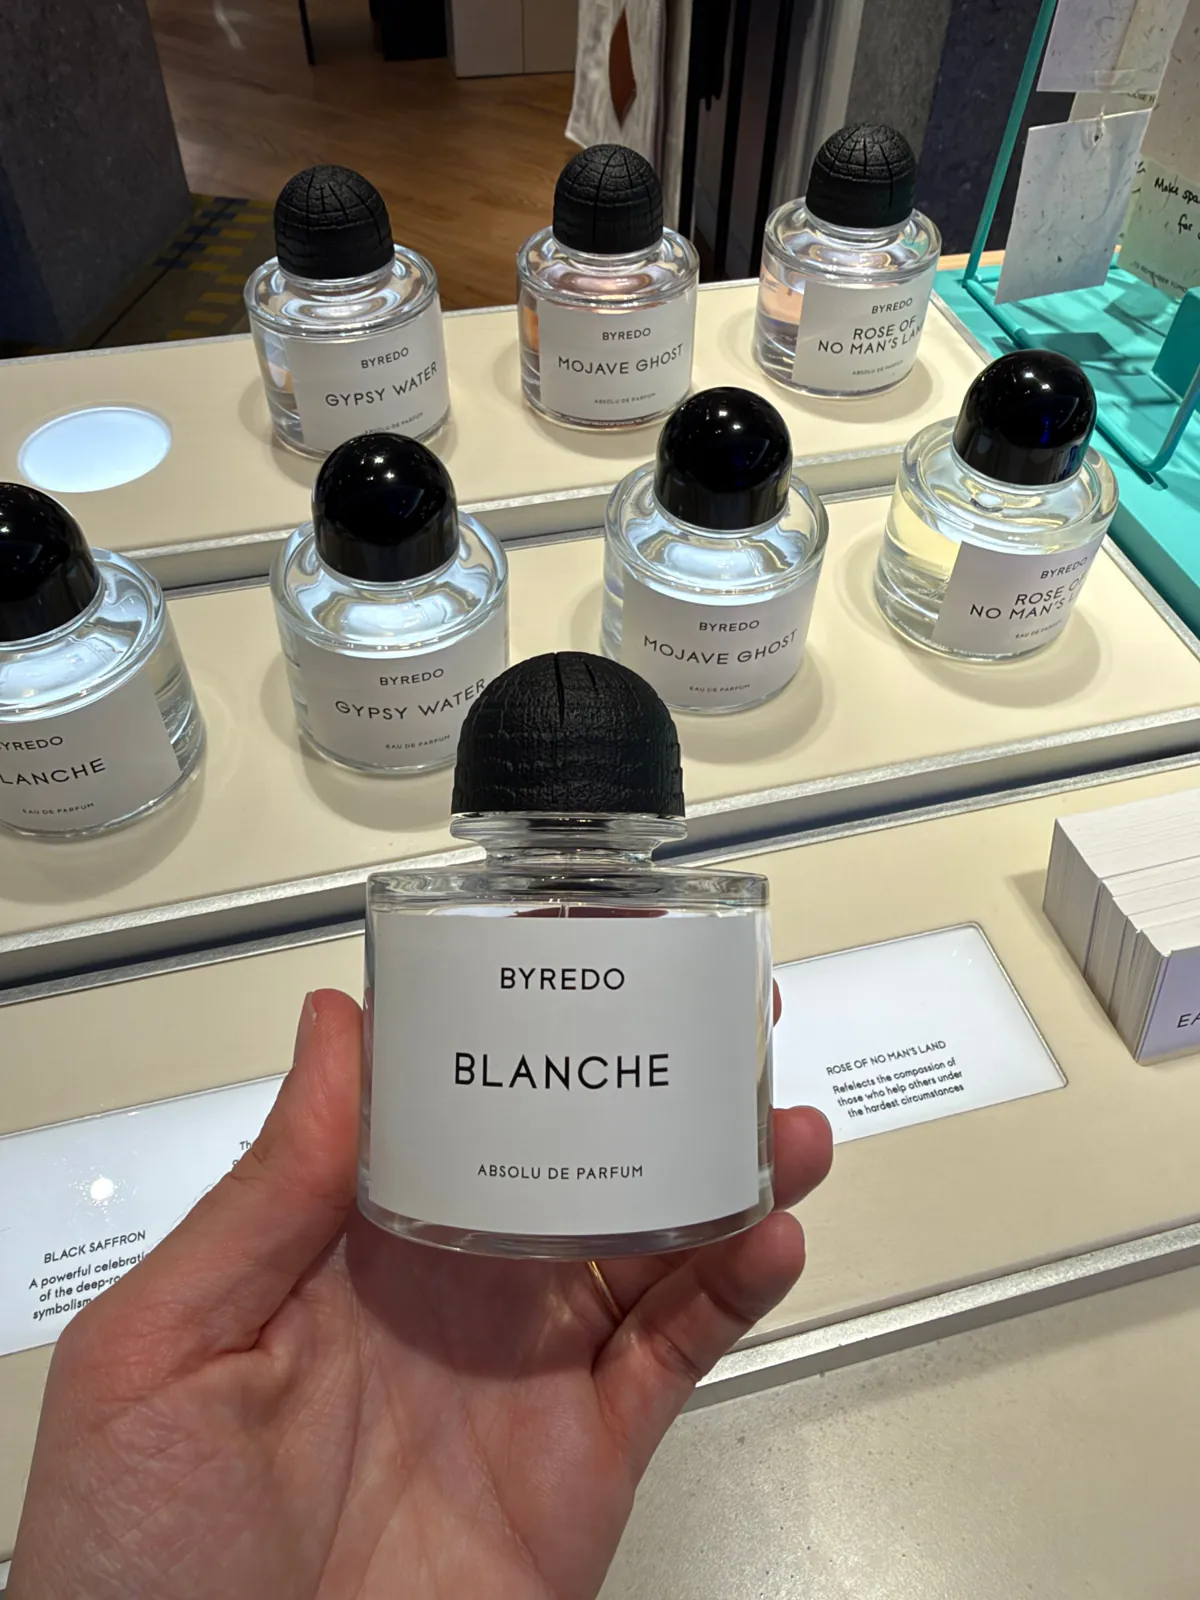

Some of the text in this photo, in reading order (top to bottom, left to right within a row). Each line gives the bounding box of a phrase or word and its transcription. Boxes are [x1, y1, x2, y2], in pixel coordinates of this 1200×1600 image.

[1154, 176, 1200, 205] Make spa
[1178, 213, 1193, 234] for
[871, 297, 913, 314] BYREDO
[602, 327, 651, 341] BYREDO
[818, 321, 923, 355] NO MAN'S LAN
[853, 315, 917, 341] ROSE OF
[360, 347, 409, 369] BYREDO
[558, 342, 683, 375] MOJAVE GHOST
[325, 361, 438, 407] GYPSY WATER
[1040, 556, 1088, 579] BYREDO
[1014, 585, 1065, 606] ROSE
[969, 603, 1002, 620] NO
[1008, 597, 1067, 620] MAN'S
[699, 620, 760, 633] BYREDO
[643, 628, 798, 665] MOJAVE GHOST
[379, 668, 444, 686] BYREDO
[719, 684, 750, 692] PARFUM
[335, 678, 486, 720] GYPSY WATER
[0, 736, 64, 751] YREDO
[418, 734, 451, 747] PARFUM
[0, 758, 106, 785] LANCHE
[57, 802, 94, 814] PARFUM
[500, 967, 626, 991] BYREDO
[1177, 1012, 1200, 1028] EA
[826, 1040, 947, 1075] ROSE OF NO MAN'S LAND
[454, 1052, 670, 1091] BLANCHE
[832, 1057, 957, 1095] Refelects the compassion of
[837, 1071, 963, 1106] those who help others under
[847, 1084, 965, 1118] the hardest circumstances
[478, 1164, 644, 1180] ABSOLU DE PARFUM
[44, 1230, 146, 1263] BLACK SAFFRON
[28, 1251, 147, 1289] A powerful celebrati
[39, 1275, 121, 1302] of the deep-ro
